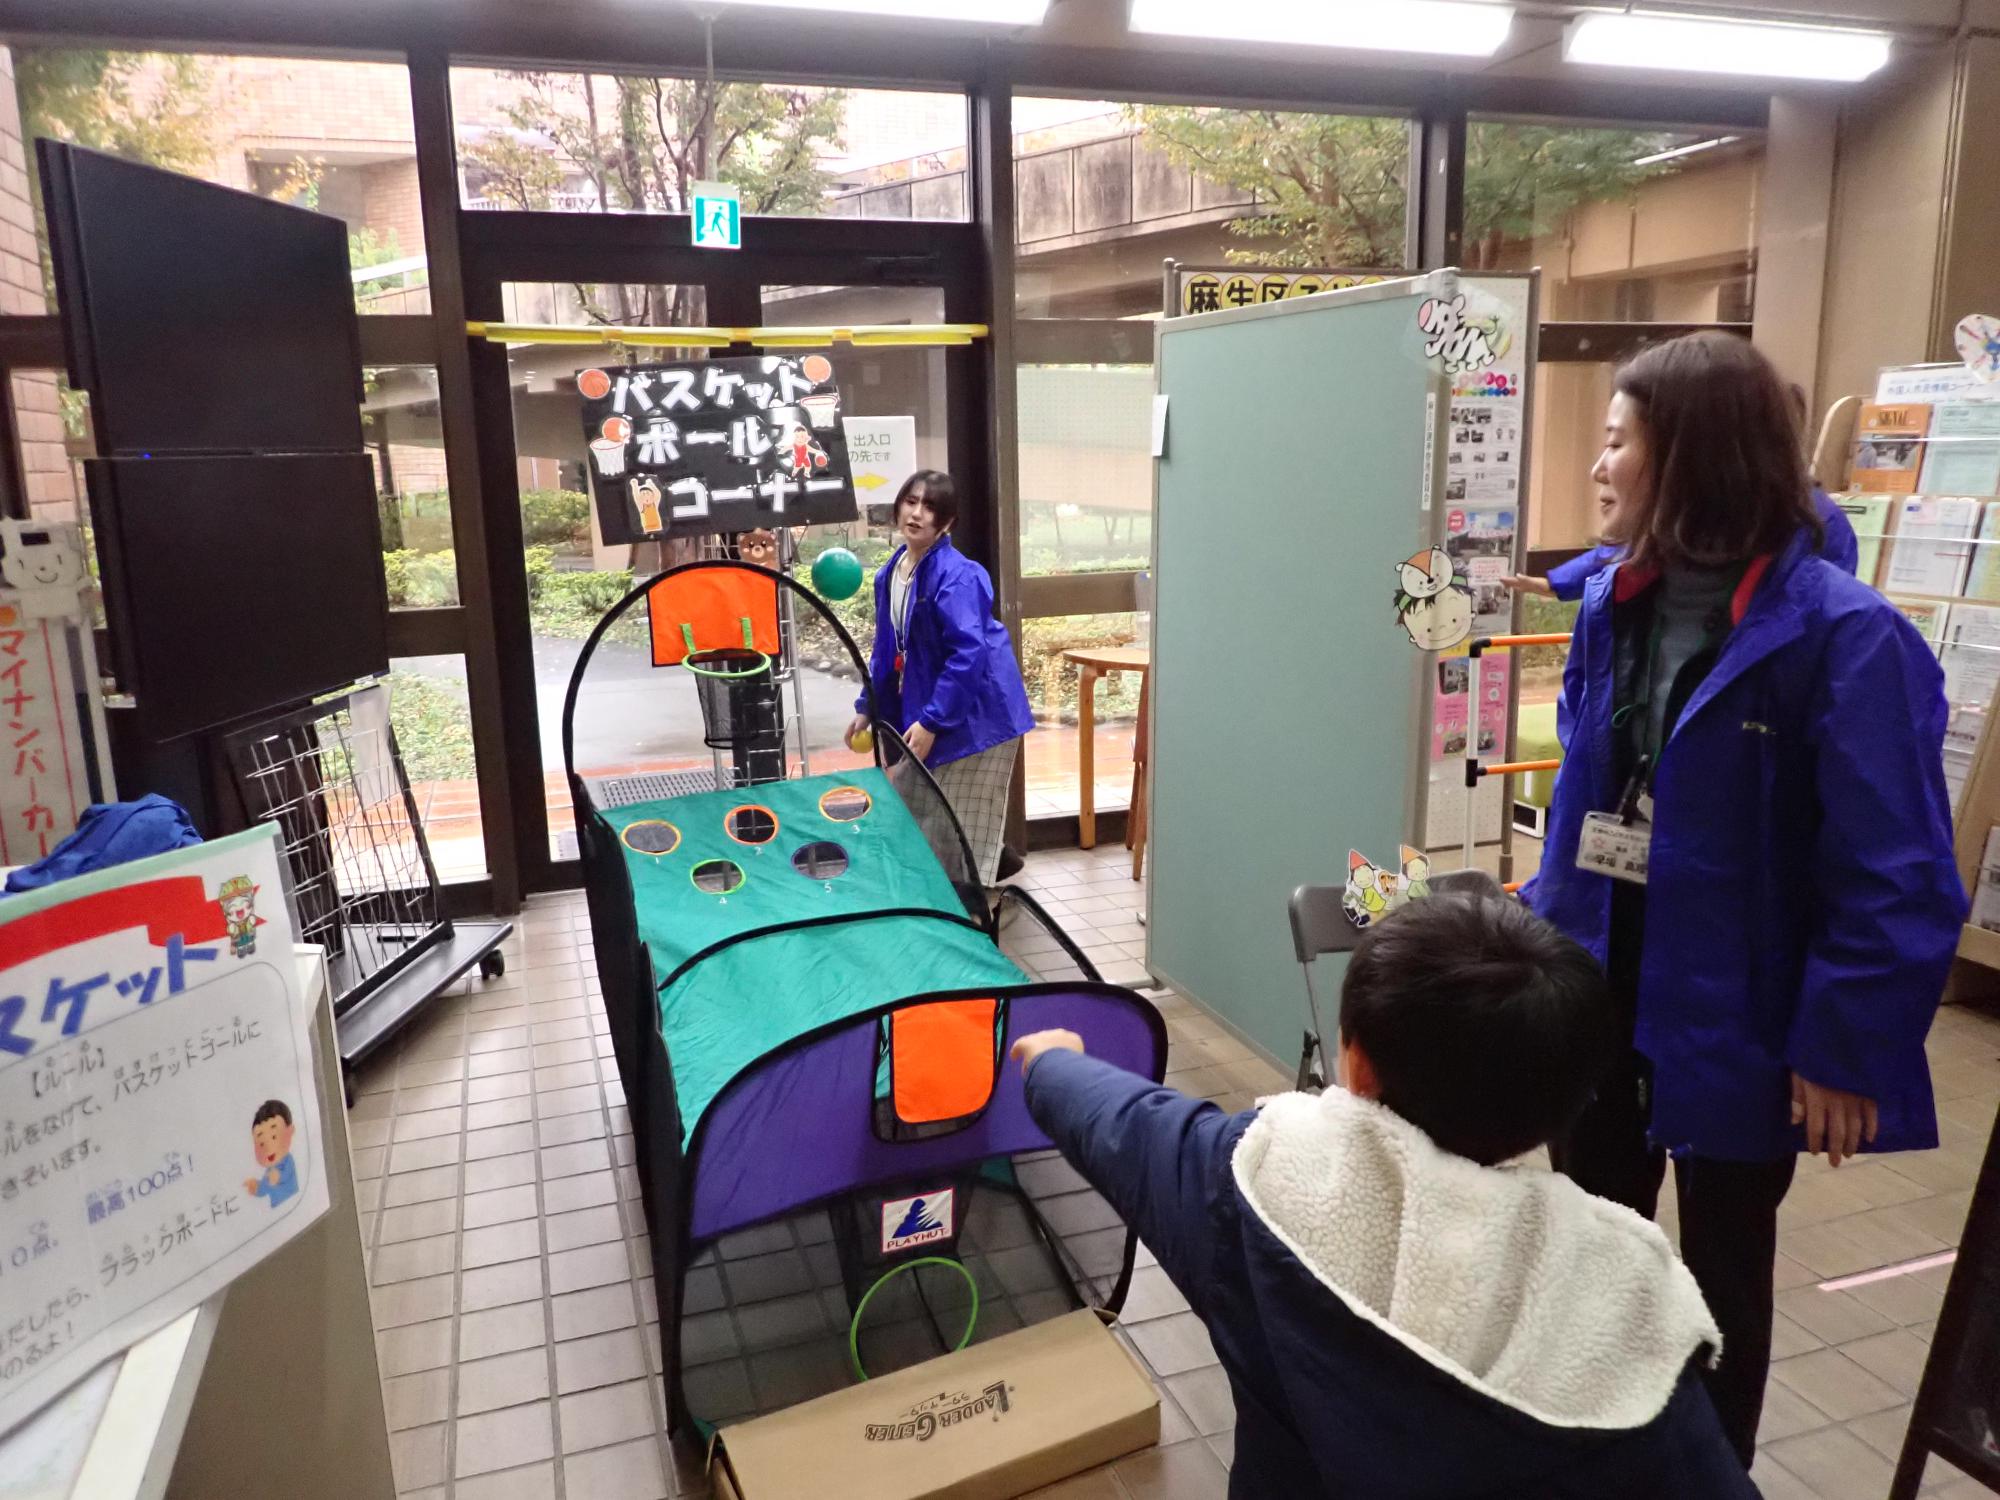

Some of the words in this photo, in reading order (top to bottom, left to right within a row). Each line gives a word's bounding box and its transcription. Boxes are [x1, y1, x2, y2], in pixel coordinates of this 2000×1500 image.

[1190, 280, 1355, 313] 麻生区
[612, 360, 814, 414] バスケット
[853, 433, 891, 448] 出入口
[849, 450, 891, 463] の先です
[667, 471, 844, 519] コーナー
[887, 1228, 947, 1250] PLAYHUT
[938, 1380, 1010, 1428] LADDER
[864, 1411, 937, 1441] GETTER
